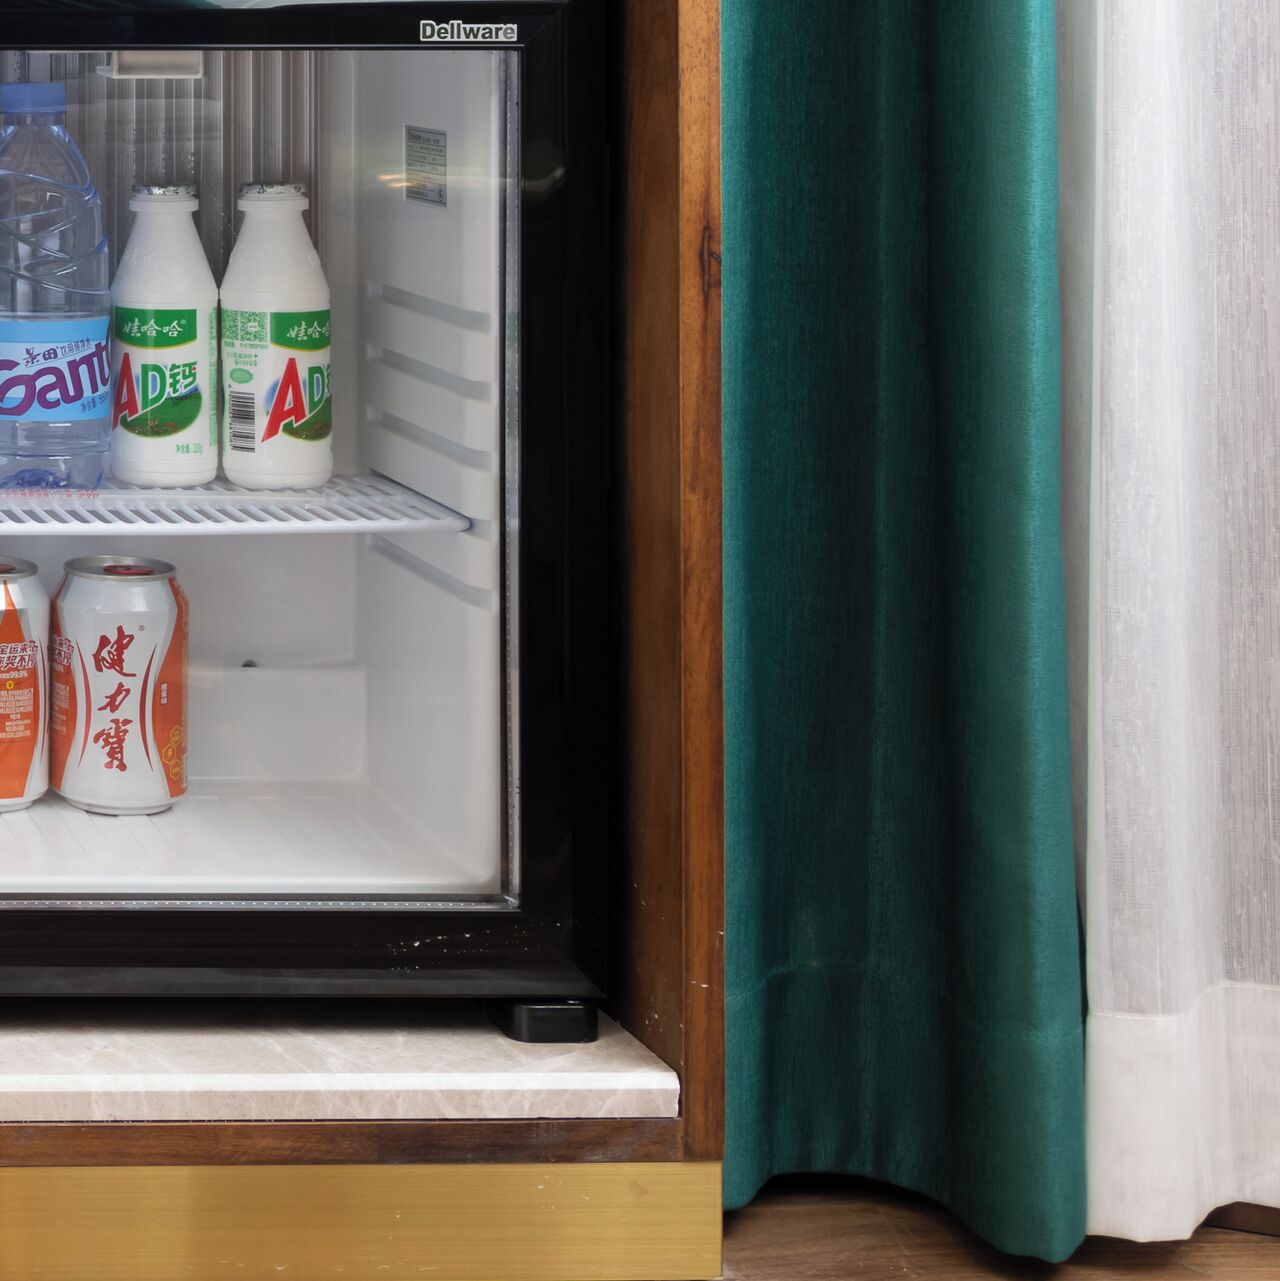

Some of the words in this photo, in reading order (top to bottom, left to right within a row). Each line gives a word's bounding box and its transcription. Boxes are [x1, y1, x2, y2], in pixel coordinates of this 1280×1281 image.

[420, 21, 517, 40] Dellware
[123, 317, 183, 337] 娃哈哈
[261, 357, 330, 443] AD
